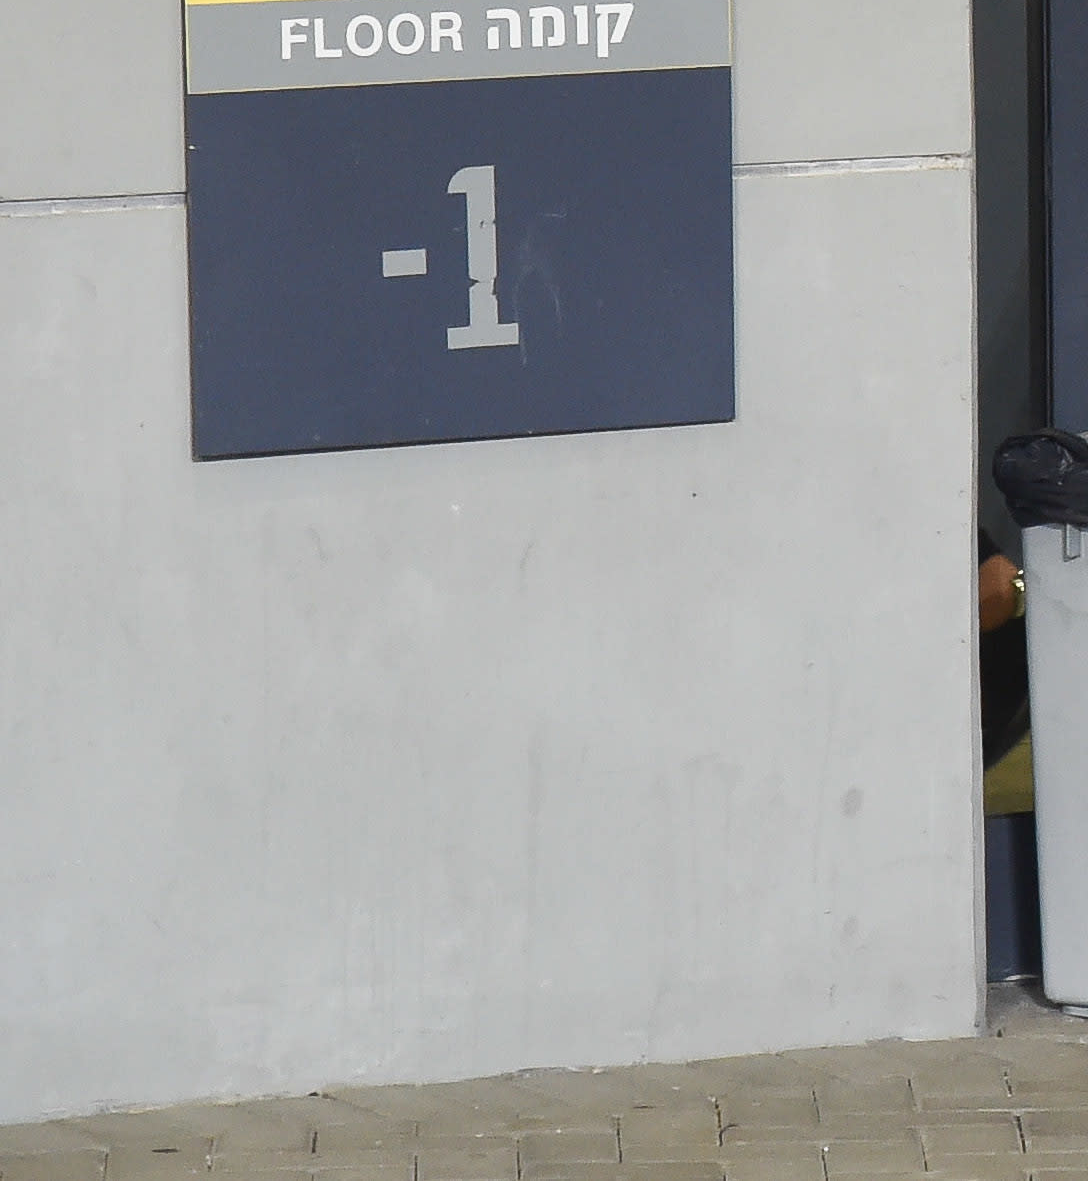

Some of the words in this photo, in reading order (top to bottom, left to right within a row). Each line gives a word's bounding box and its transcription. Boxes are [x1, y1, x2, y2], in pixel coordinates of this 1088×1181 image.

[280, 10, 464, 60] FLOOR
[486, 2, 635, 59] קומה
[382, 164, 520, 350] -1
